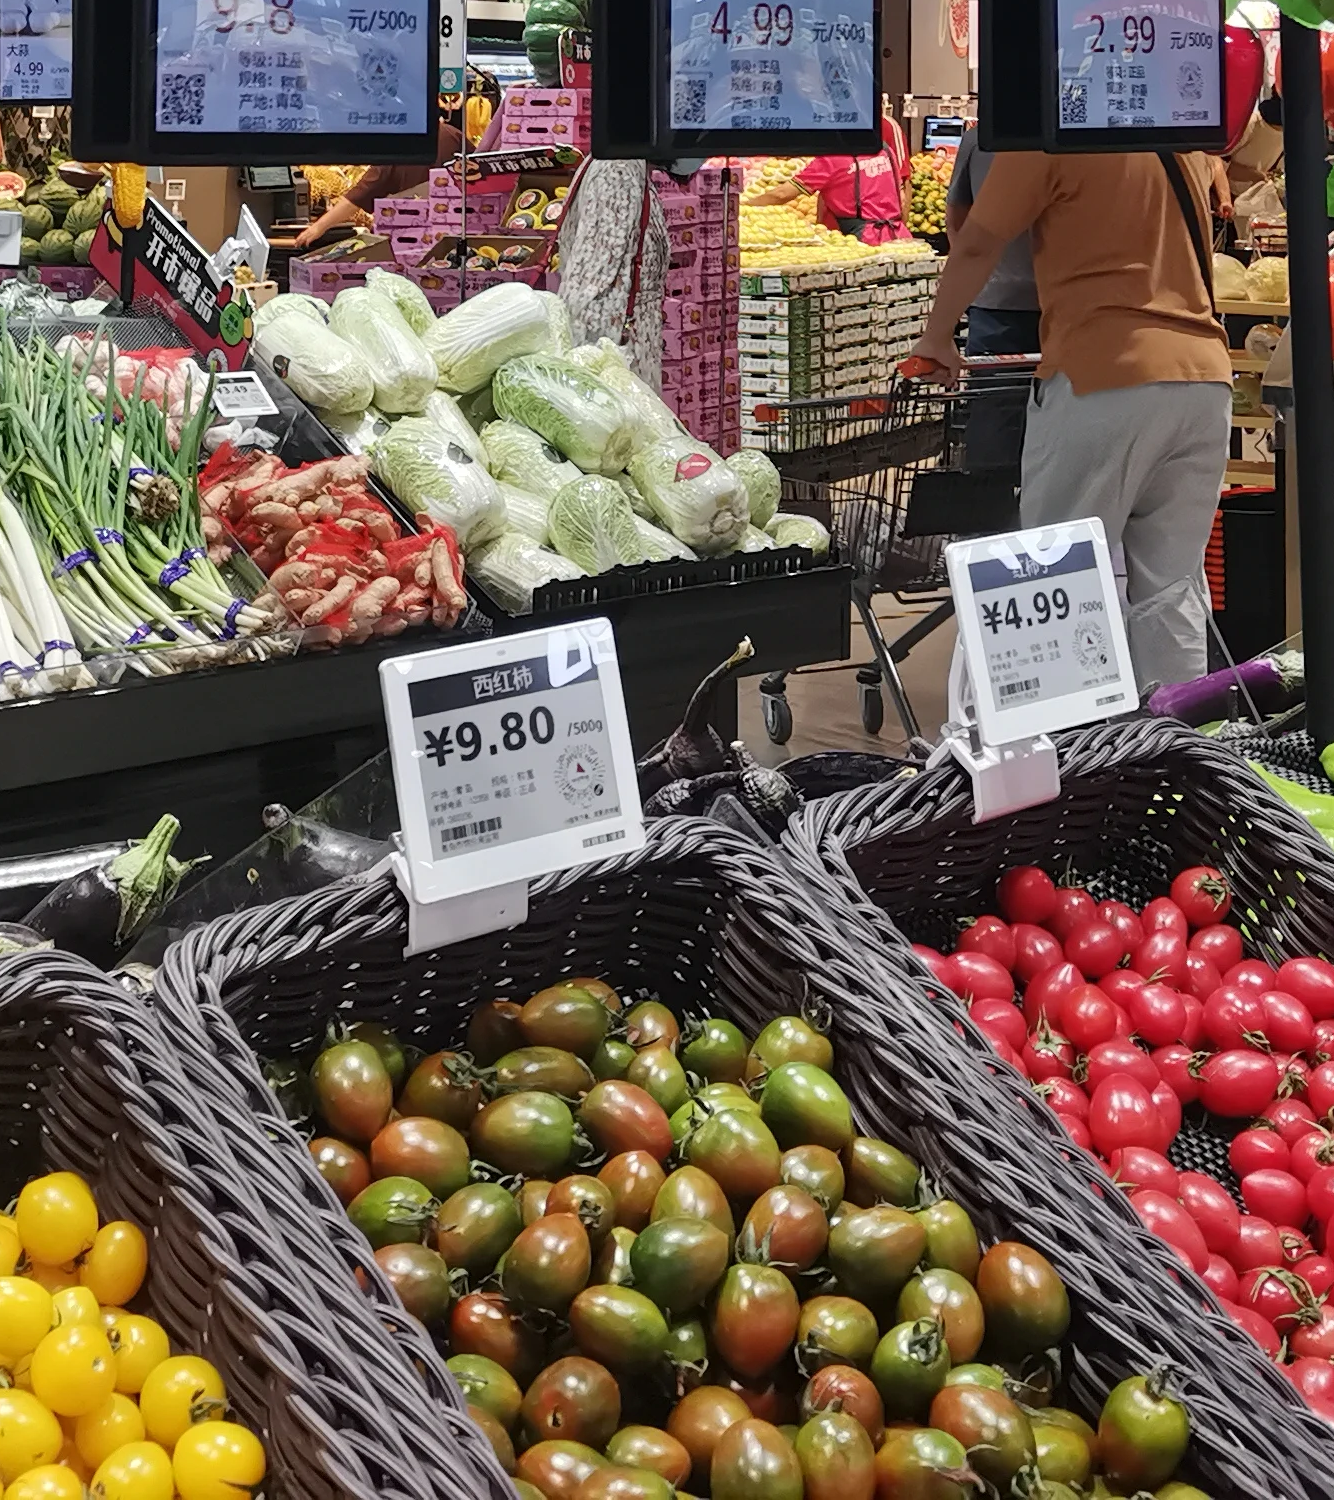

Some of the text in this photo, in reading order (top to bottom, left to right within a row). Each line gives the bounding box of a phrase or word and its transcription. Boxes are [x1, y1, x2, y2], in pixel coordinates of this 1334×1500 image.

[348, 9, 417, 33] 元/500g
[711, 2, 794, 46] 4.99
[1090, 15, 1213, 54] 2.99 元/500g
[7, 43, 29, 57] 大蒜
[13, 62, 44, 76] 4.99
[145, 206, 202, 272] Promotional
[145, 232, 217, 324] 开市爆品
[981, 588, 1104, 634] ¥4.99 /500g
[471, 664, 534, 700] 西红柿
[423, 705, 604, 768] ¥9.80 /500g
